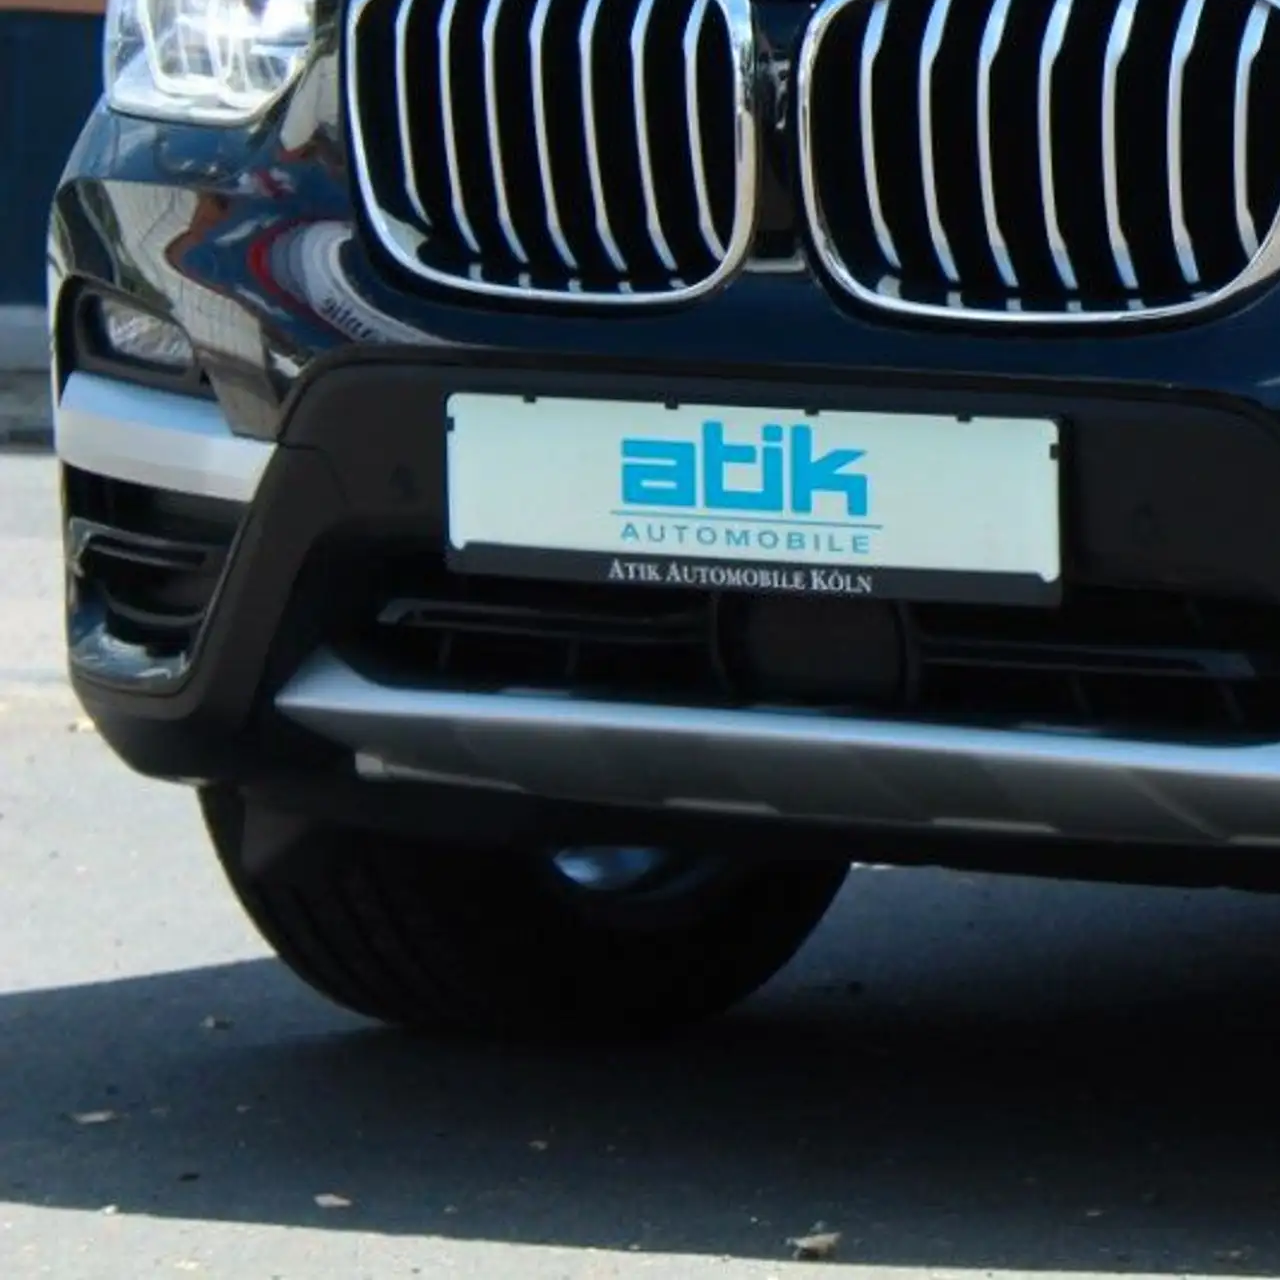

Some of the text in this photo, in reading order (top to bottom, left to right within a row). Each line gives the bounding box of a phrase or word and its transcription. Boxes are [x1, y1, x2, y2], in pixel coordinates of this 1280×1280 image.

[621, 420, 868, 516] atik
[620, 522, 870, 554] AUTOMOBILE
[608, 558, 873, 593] ATIK AUTOMOBILE KÖLN
